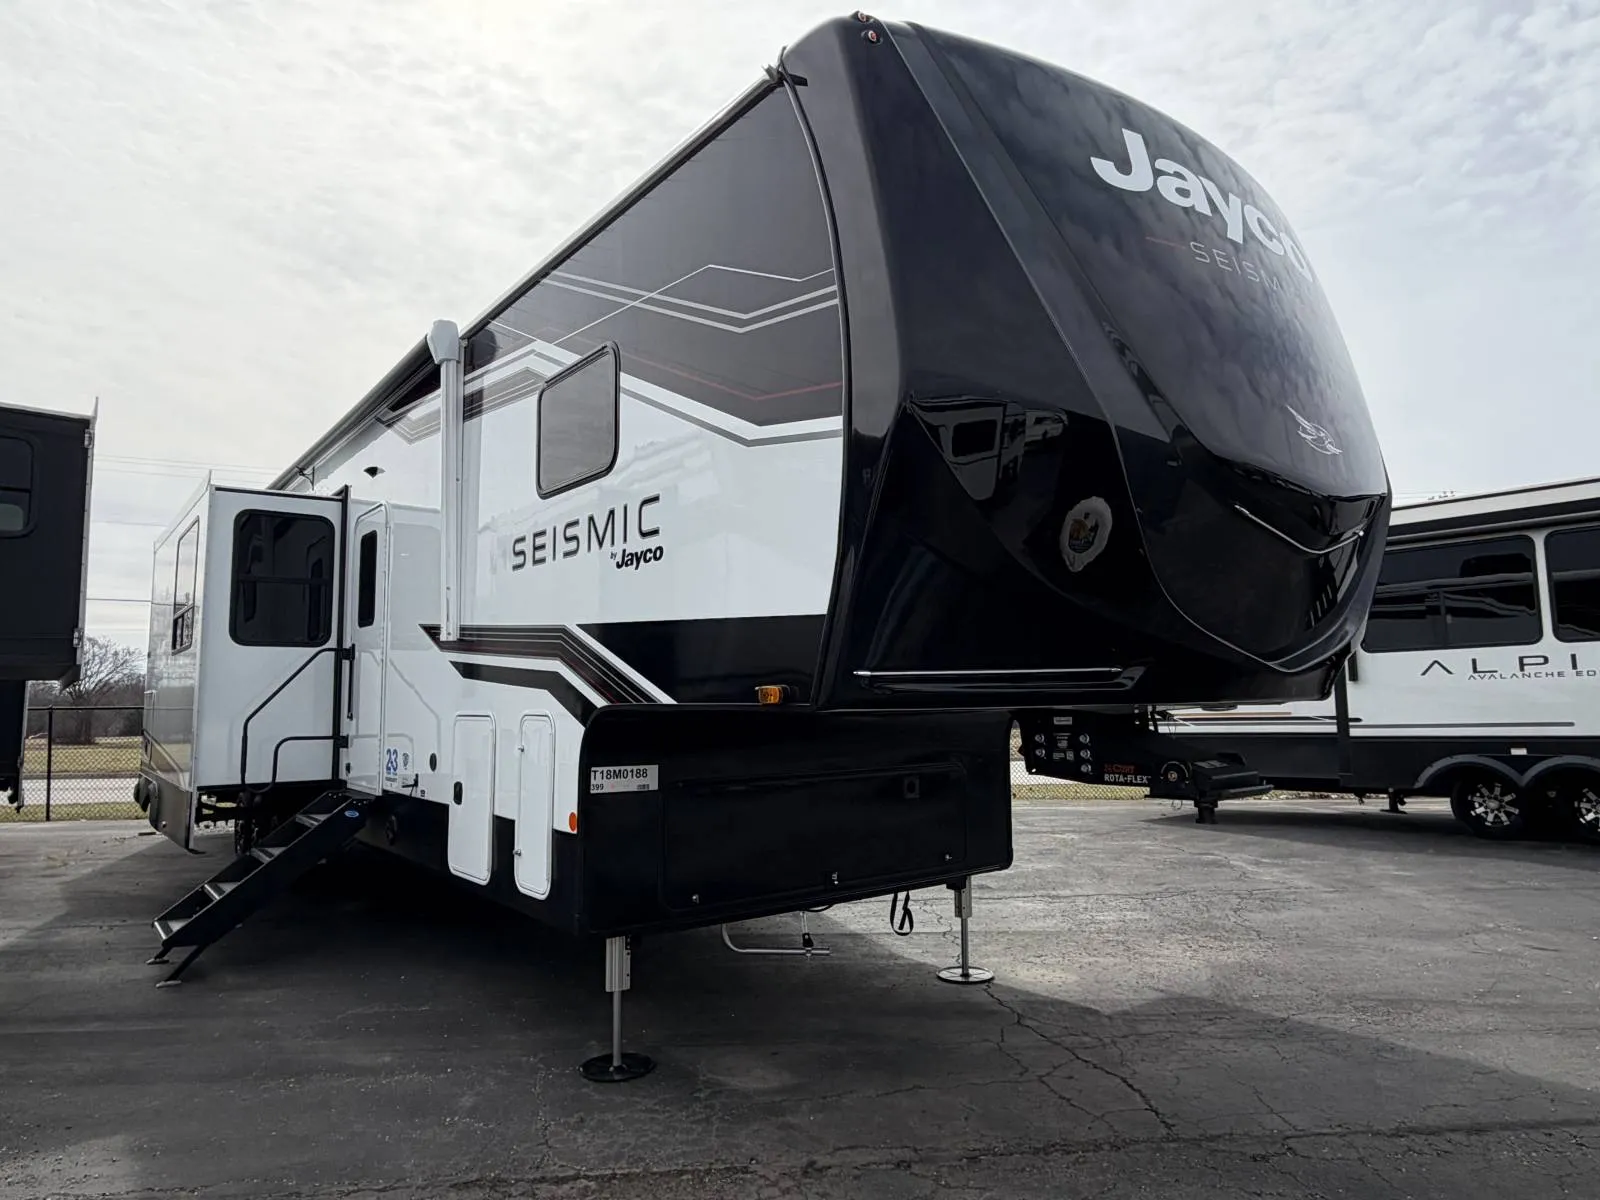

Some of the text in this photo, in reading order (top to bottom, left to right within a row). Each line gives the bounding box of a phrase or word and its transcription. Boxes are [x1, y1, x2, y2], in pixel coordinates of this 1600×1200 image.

[1090, 128, 1313, 283] Jayco
[512, 493, 661, 571] SEISMIC
[610, 545, 664, 570] by Jayco
[1420, 653, 1578, 677] ALPI
[1468, 671, 1566, 681] AVALANCHE
[591, 768, 648, 781] T18M0188
